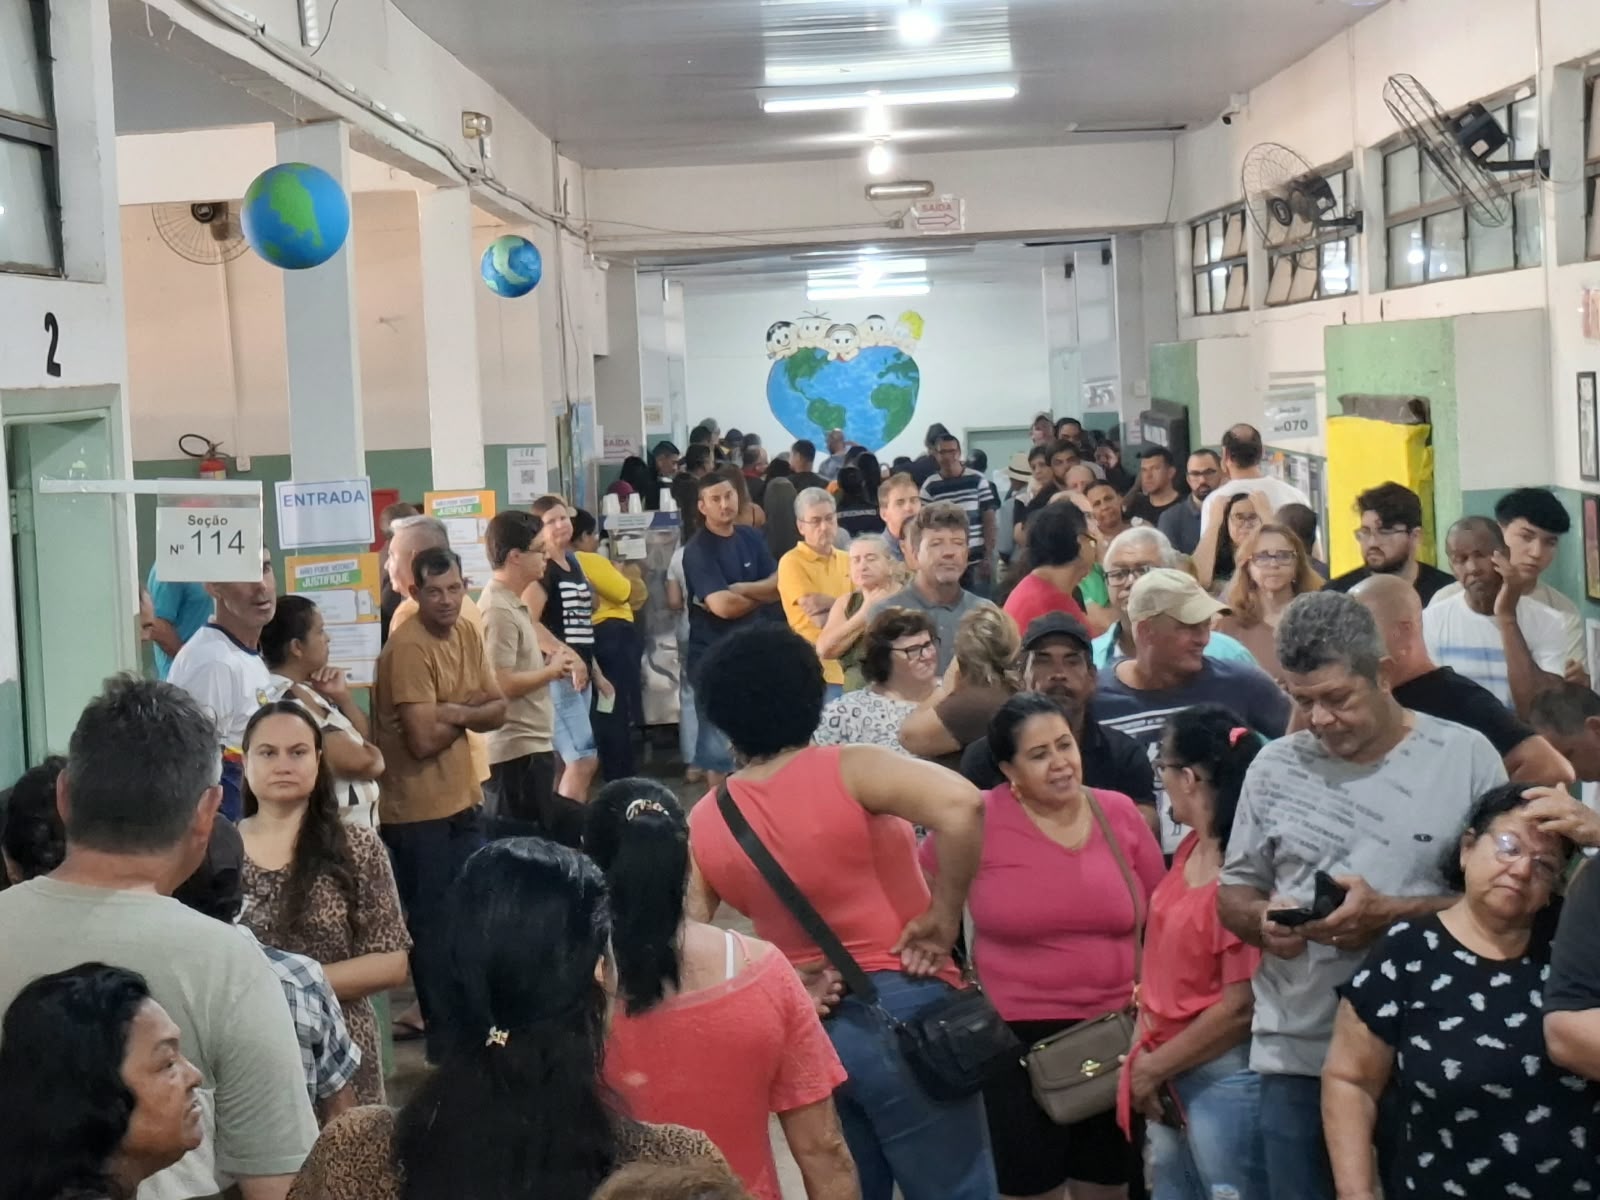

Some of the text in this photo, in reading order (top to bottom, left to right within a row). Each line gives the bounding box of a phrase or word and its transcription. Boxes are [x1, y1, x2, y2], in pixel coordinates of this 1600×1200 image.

[44, 312, 61, 377] 2
[1283, 419, 1308, 432] 070
[283, 490, 365, 507] ENTRADA
[187, 514, 228, 528] Seção
[191, 529, 245, 555] 114
[302, 572, 350, 587] JUSTIFIQUE
